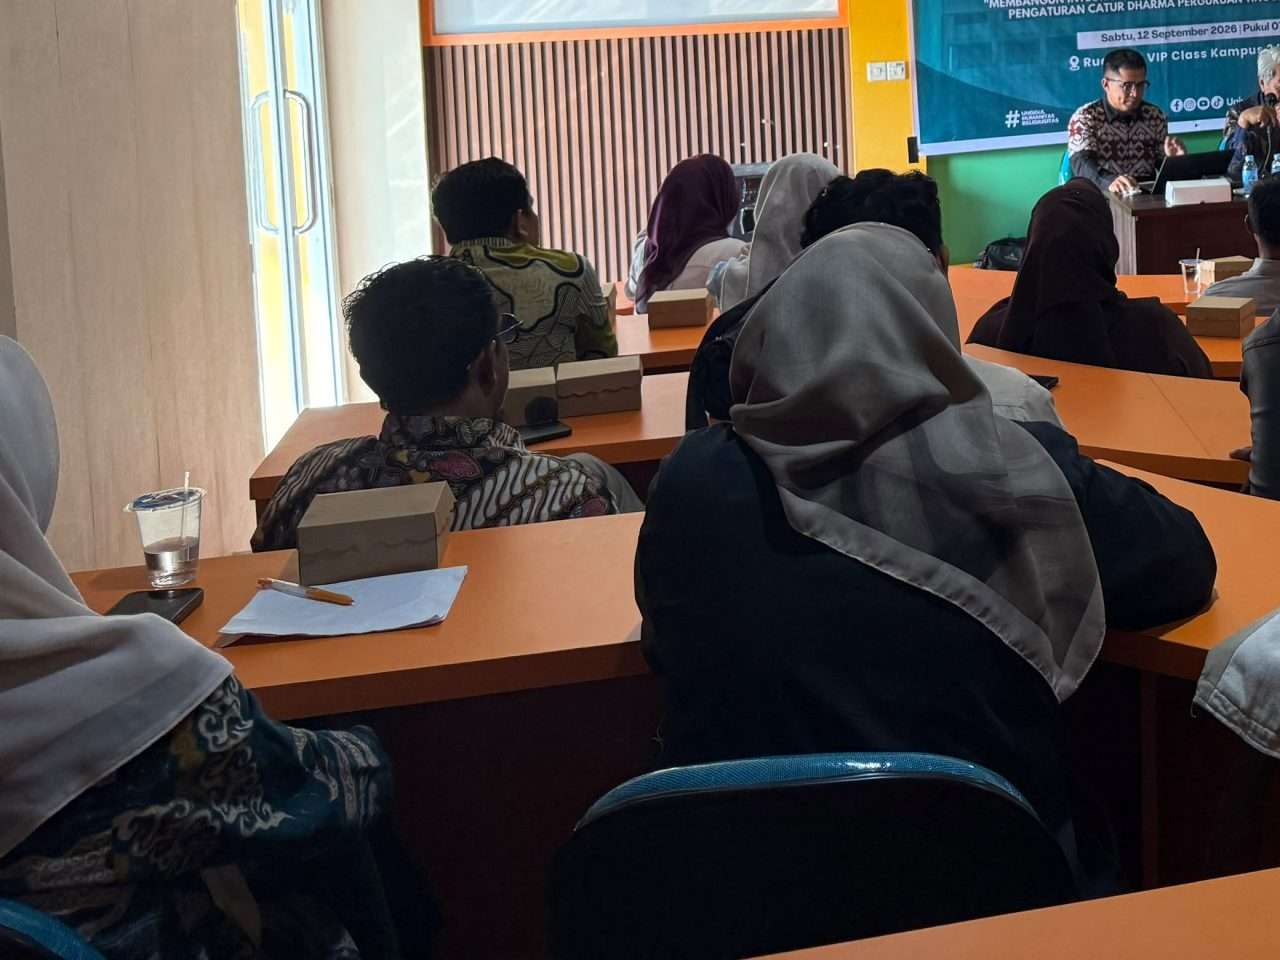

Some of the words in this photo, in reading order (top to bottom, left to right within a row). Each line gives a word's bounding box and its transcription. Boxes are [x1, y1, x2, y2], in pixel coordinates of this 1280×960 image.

[1008, 2, 1085, 19] PENGATURAN
[1087, 0, 1125, 14] CATUR
[1101, 31, 1136, 43] Sabtu,
[1137, 30, 1150, 41] 12
[1151, 25, 1209, 41] September
[1210, 24, 1237, 35] 2026
[1242, 22, 1270, 33] Pukul
[1147, 51, 1168, 63] VIP
[1171, 48, 1207, 61] Class
